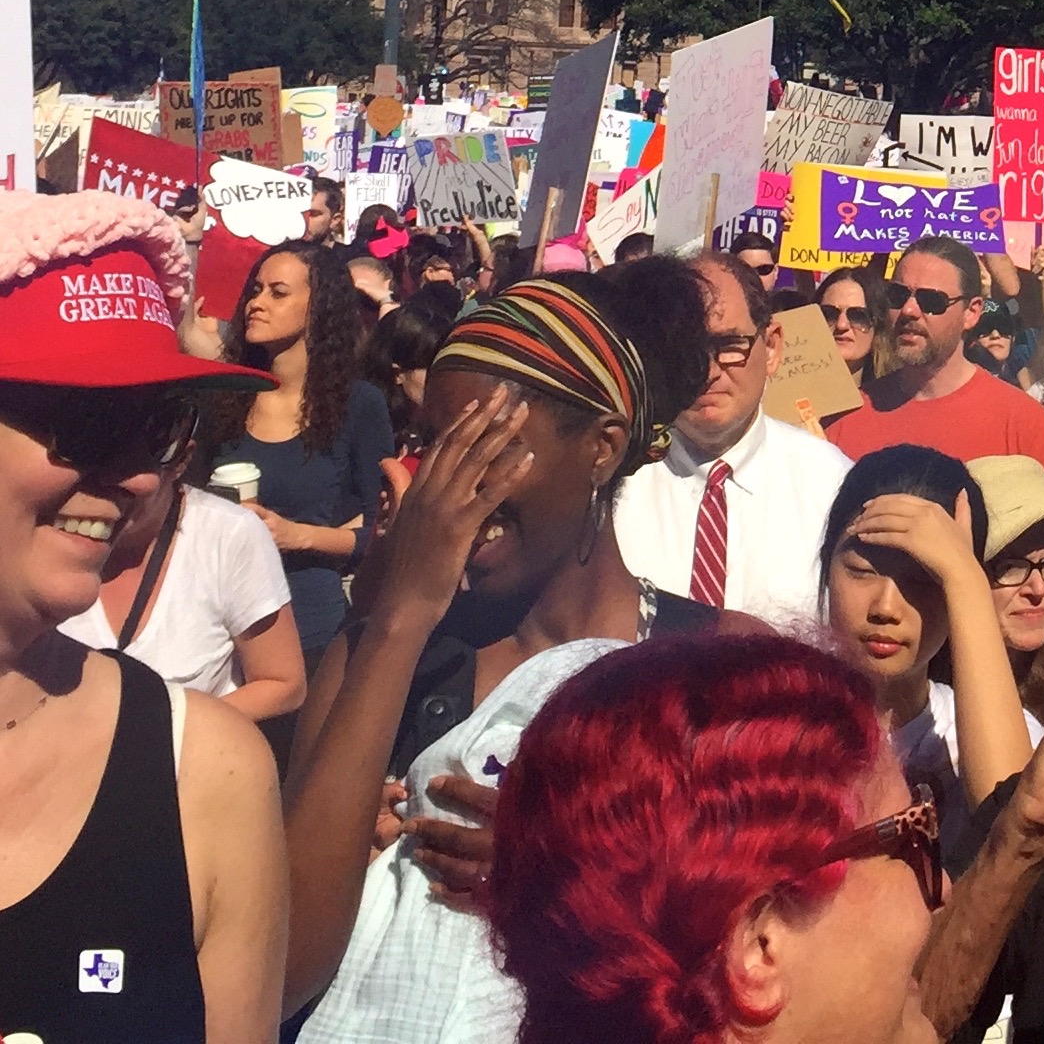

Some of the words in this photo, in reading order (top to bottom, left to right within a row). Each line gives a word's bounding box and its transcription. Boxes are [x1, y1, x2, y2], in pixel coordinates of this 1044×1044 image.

[169, 87, 195, 110] OU
[204, 87, 263, 110] RIGHTS
[779, 85, 894, 126] NON-NEGOTIABLE
[220, 114, 237, 126] UP
[241, 111, 264, 127] FOR
[996, 106, 1037, 123] wanna
[778, 111, 815, 136] MY
[812, 118, 852, 147] BEER
[918, 121, 957, 157] I'M
[414, 133, 502, 168] PRIDE
[765, 135, 805, 161] MY
[804, 142, 851, 165] BACON
[996, 123, 1023, 169] fun
[98, 168, 180, 209] MAKE
[880, 206, 914, 219] not
[923, 207, 974, 223] hate
[834, 223, 910, 241] MAKES
[920, 223, 1000, 242] AMERICA
[790, 247, 831, 263] DONT
[840, 252, 870, 265] TREA
[61, 273, 135, 297] MAKE
[59, 297, 138, 322] GREAT
